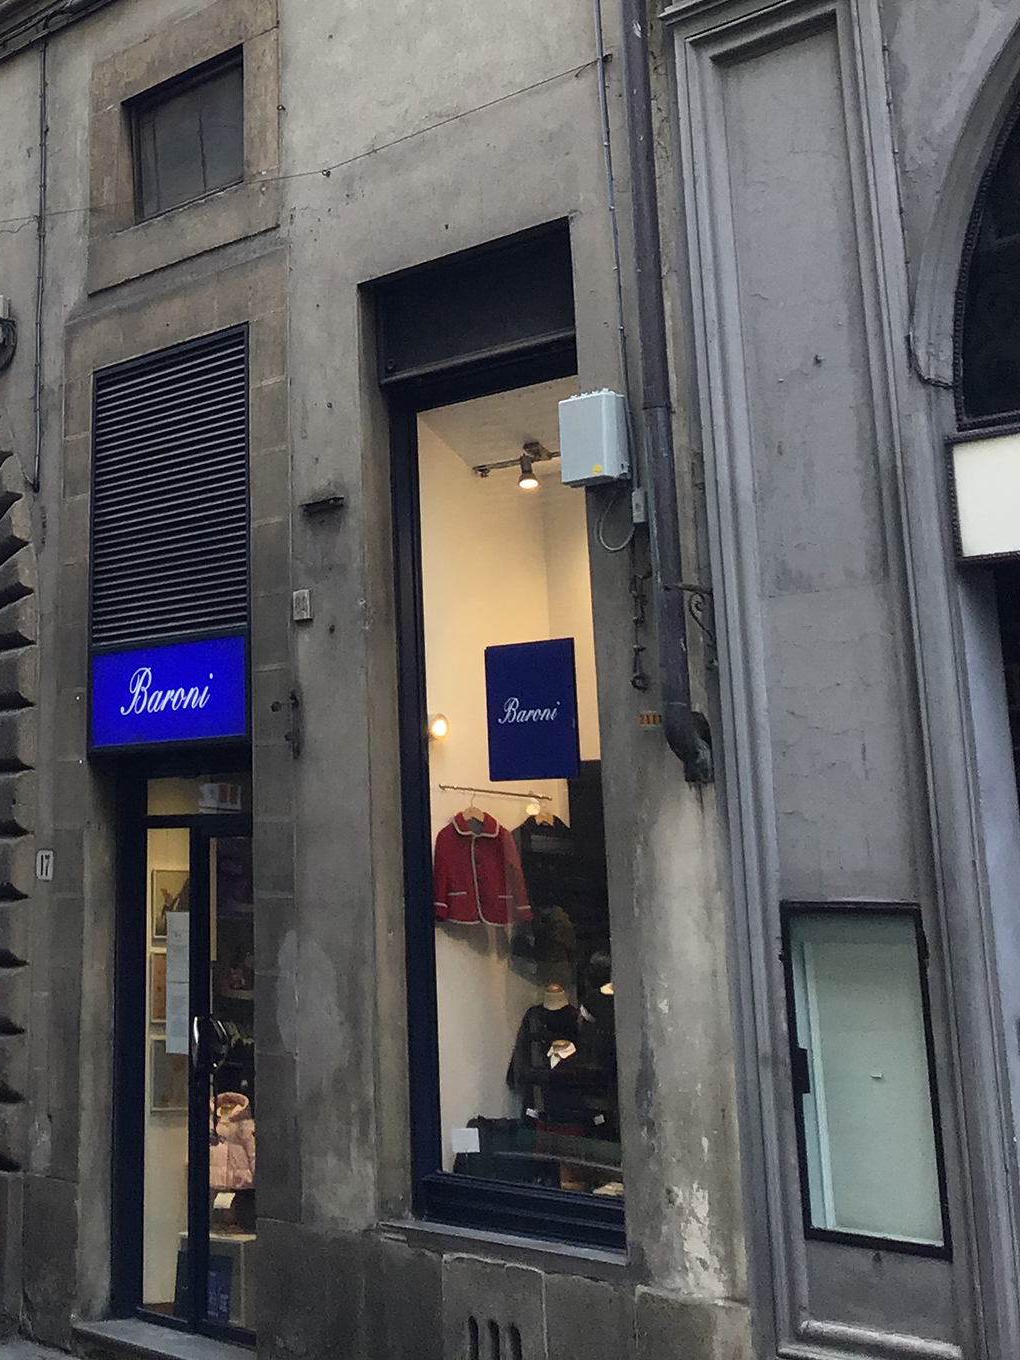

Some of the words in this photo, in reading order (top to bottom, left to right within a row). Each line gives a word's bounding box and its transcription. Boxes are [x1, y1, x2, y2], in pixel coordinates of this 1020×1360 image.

[120, 667, 213, 716] Baroni
[497, 696, 561, 724] Baroni
[40, 854, 50, 876] 17
